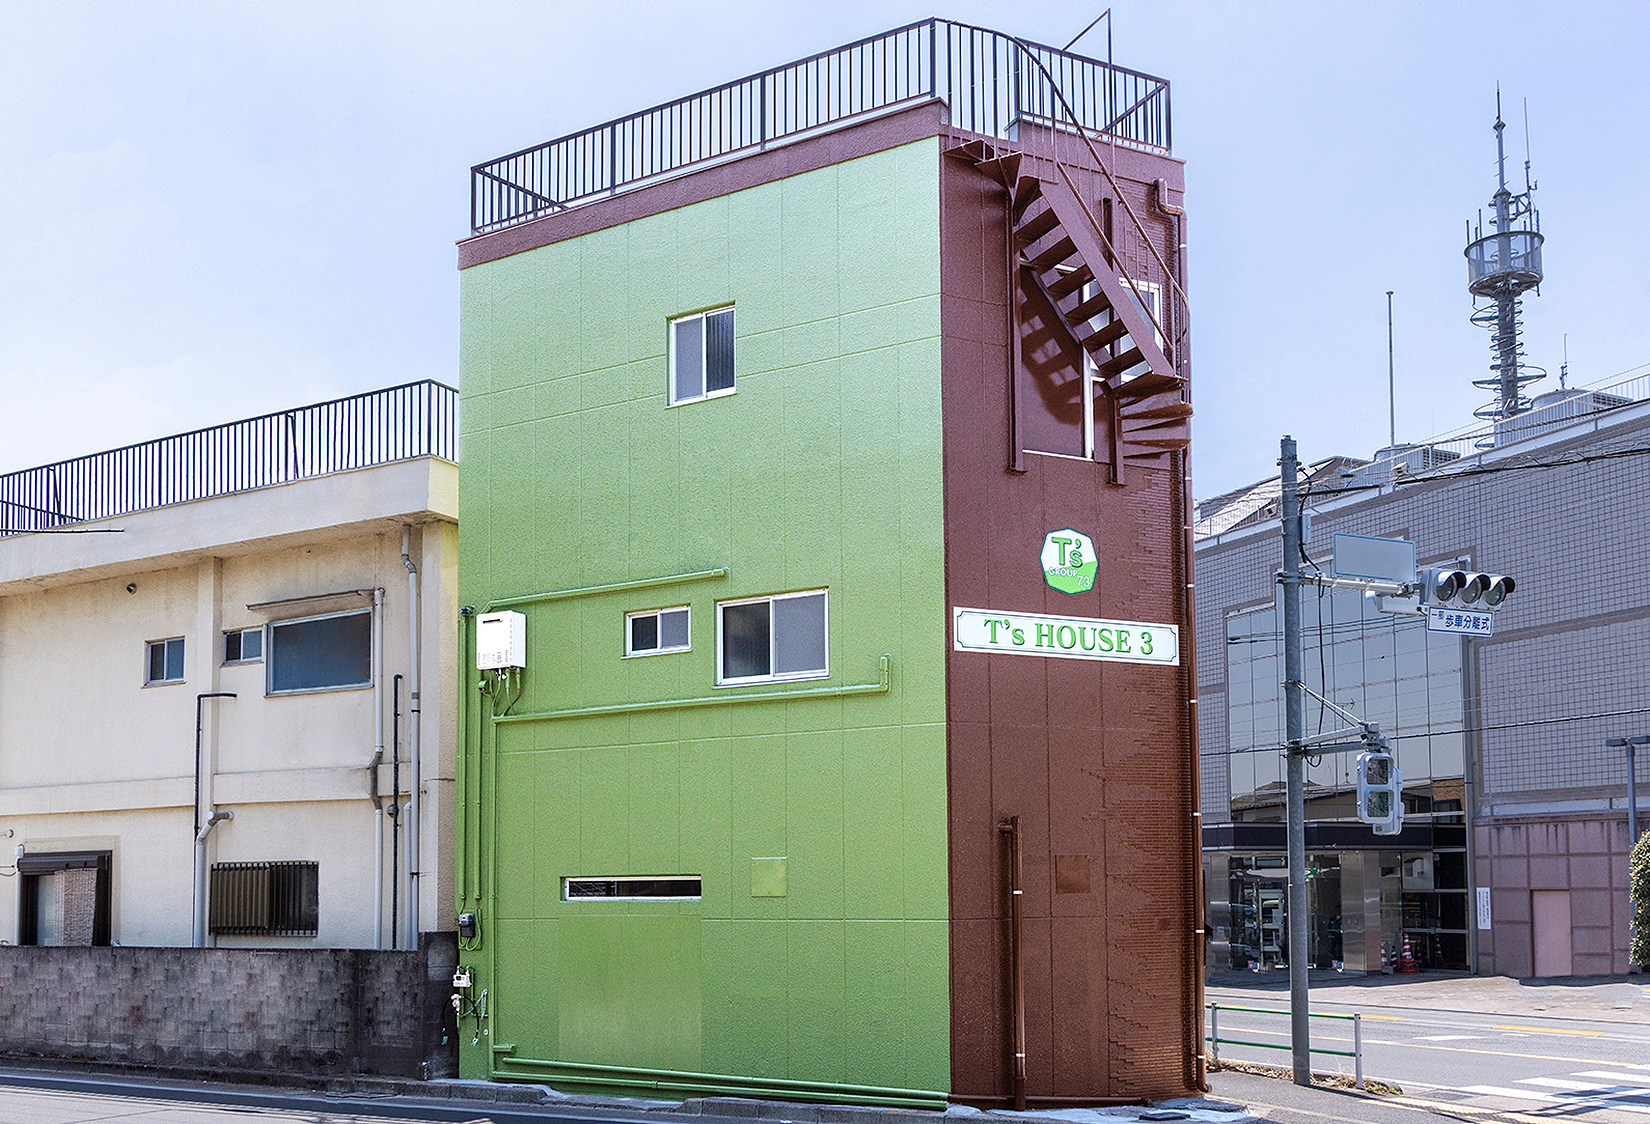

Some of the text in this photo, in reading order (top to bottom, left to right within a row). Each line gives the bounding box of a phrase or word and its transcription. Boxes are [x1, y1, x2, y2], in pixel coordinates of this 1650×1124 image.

[1051, 536, 1083, 568] T's
[1048, 566, 1079, 578] GROUP
[1077, 575, 1091, 588] 73
[983, 618, 1154, 655] T's HOUSE 3
